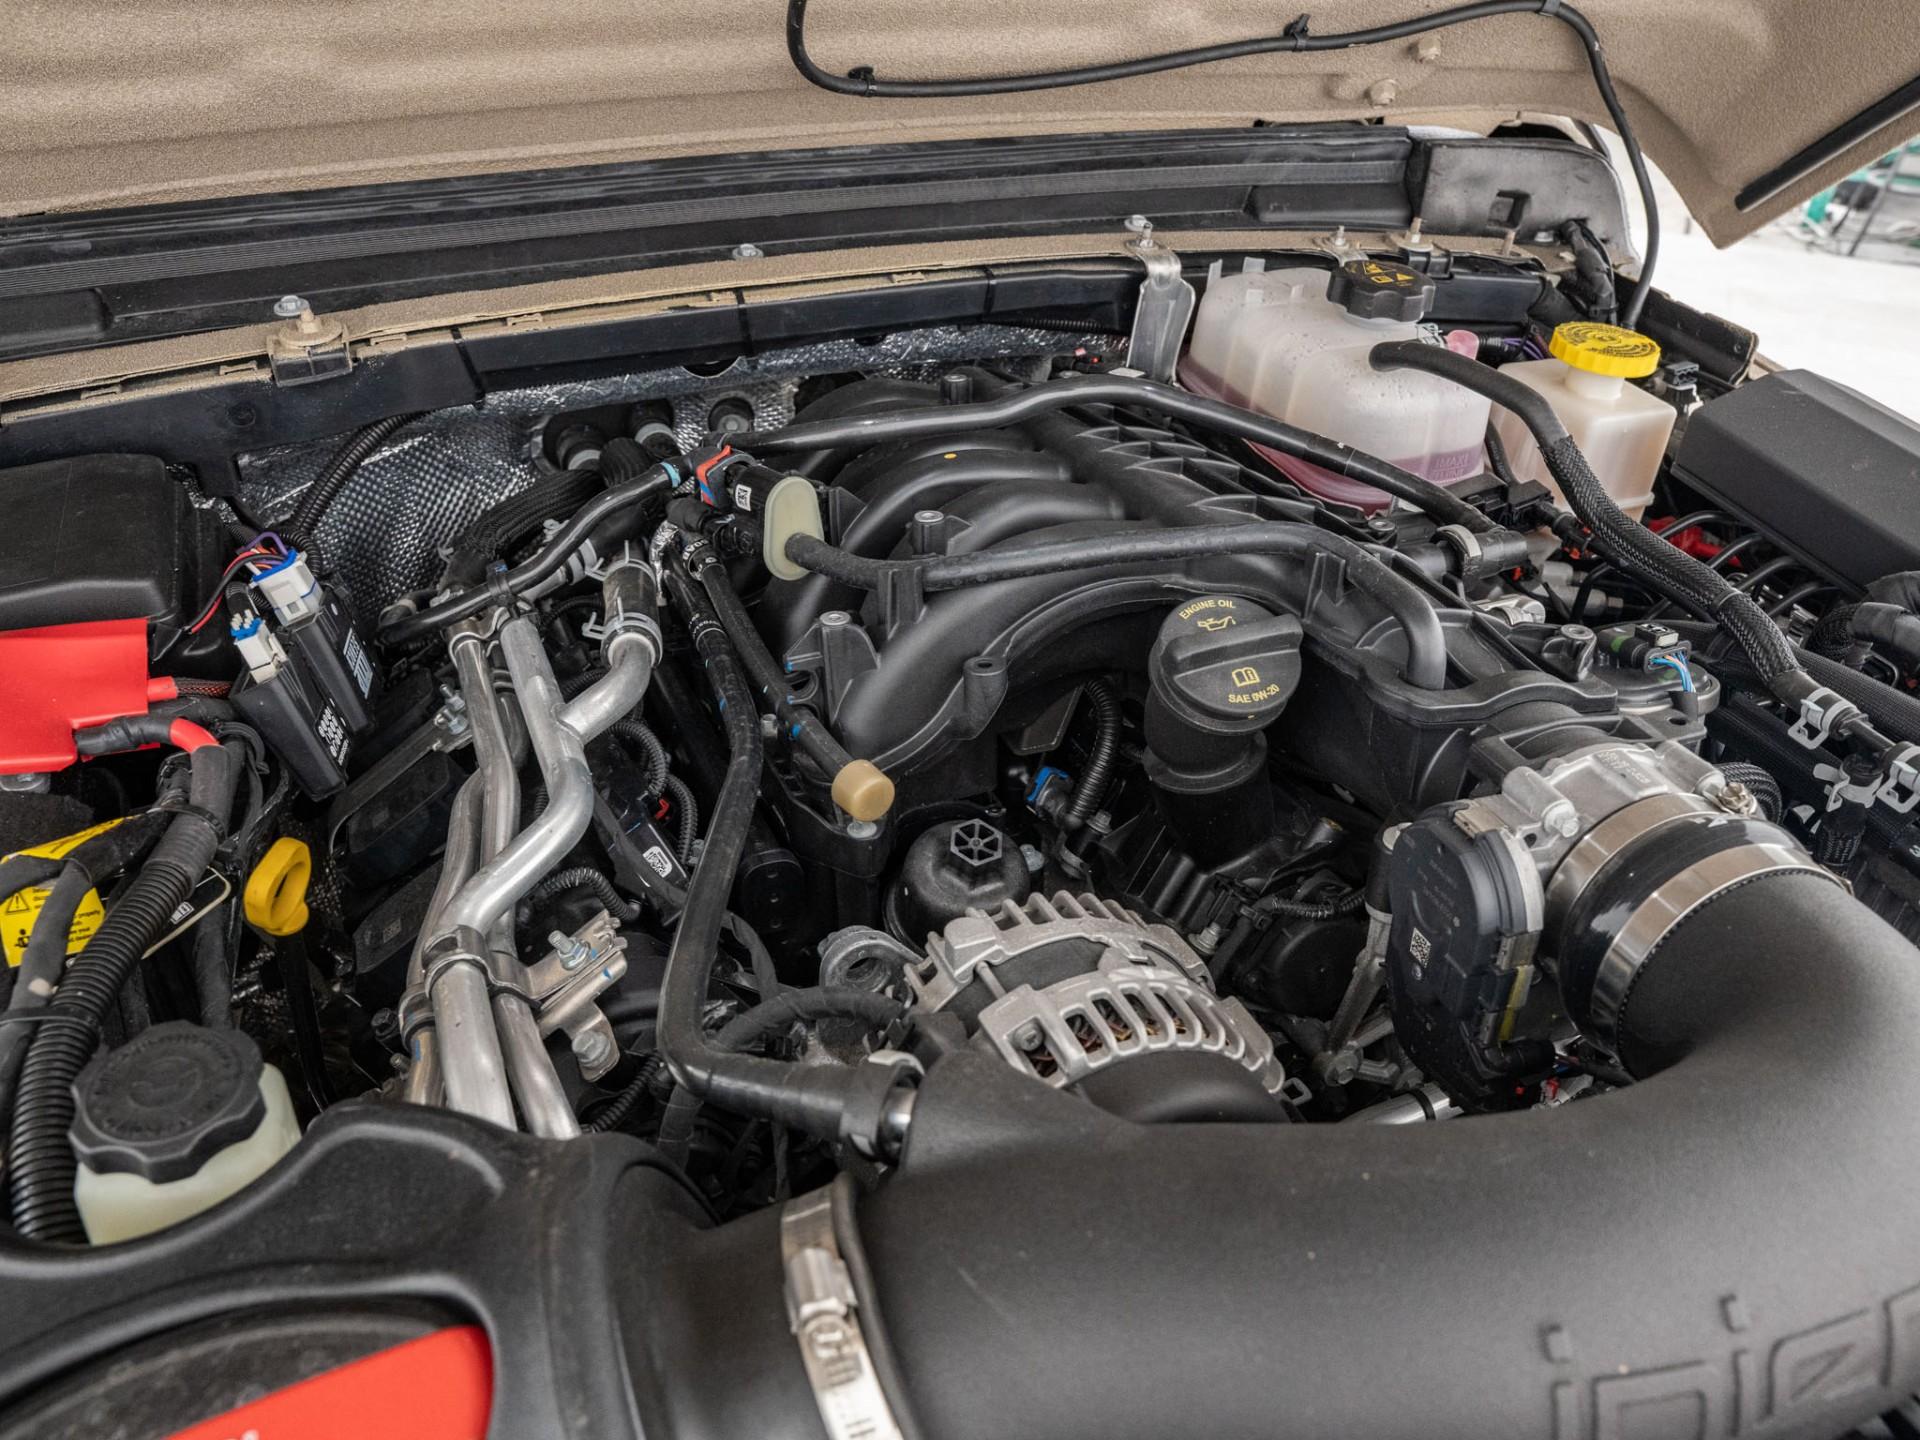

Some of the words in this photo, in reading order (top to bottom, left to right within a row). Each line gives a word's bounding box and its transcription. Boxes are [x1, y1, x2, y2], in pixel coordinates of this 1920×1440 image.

[1179, 599, 1216, 619] ENGINE
[1217, 599, 1236, 609] OIL
[1228, 693, 1252, 704] SAE
[1252, 684, 1280, 702] 0W-20
